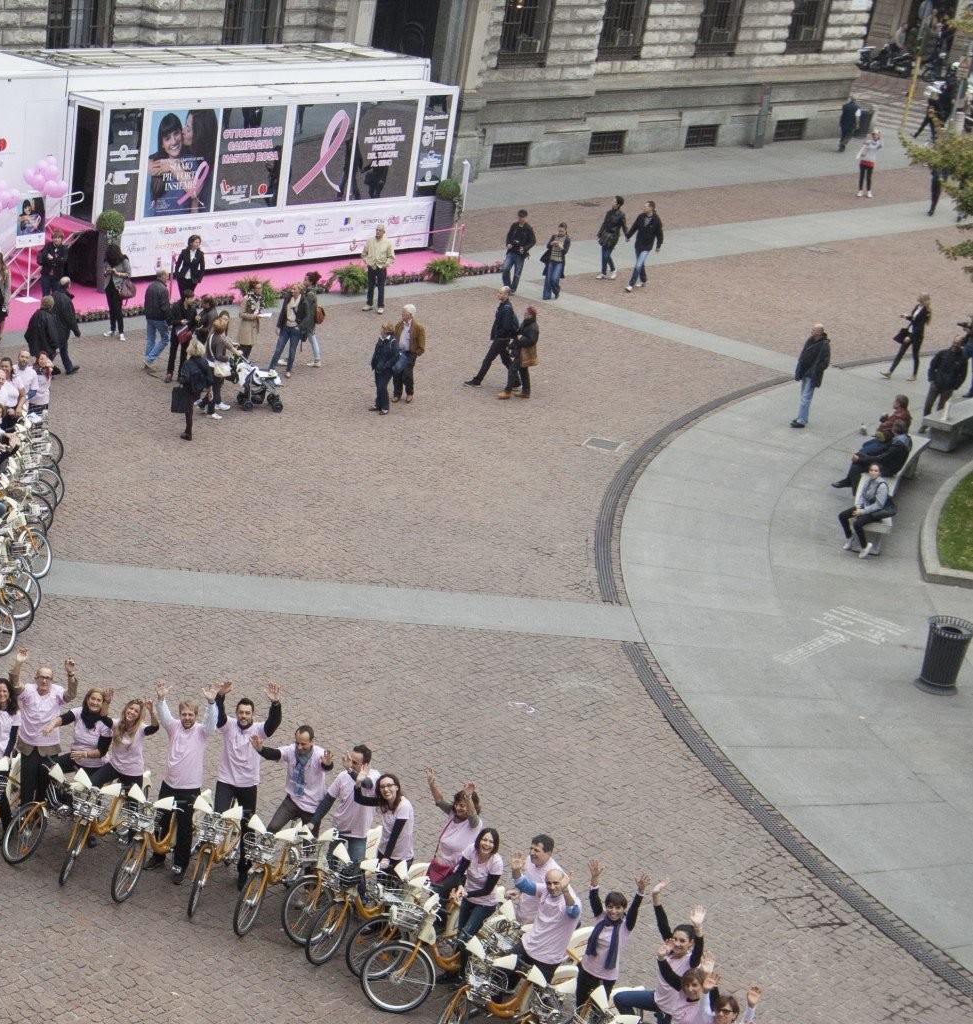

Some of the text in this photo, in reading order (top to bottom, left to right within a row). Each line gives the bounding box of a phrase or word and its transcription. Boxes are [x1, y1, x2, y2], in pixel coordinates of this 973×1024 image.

[222, 127, 263, 140] OTTOBRE
[227, 138, 274, 151] CAMPAGNA
[221, 150, 279, 165] NASTRO ROSA
[169, 160, 194, 171] SIAMO
